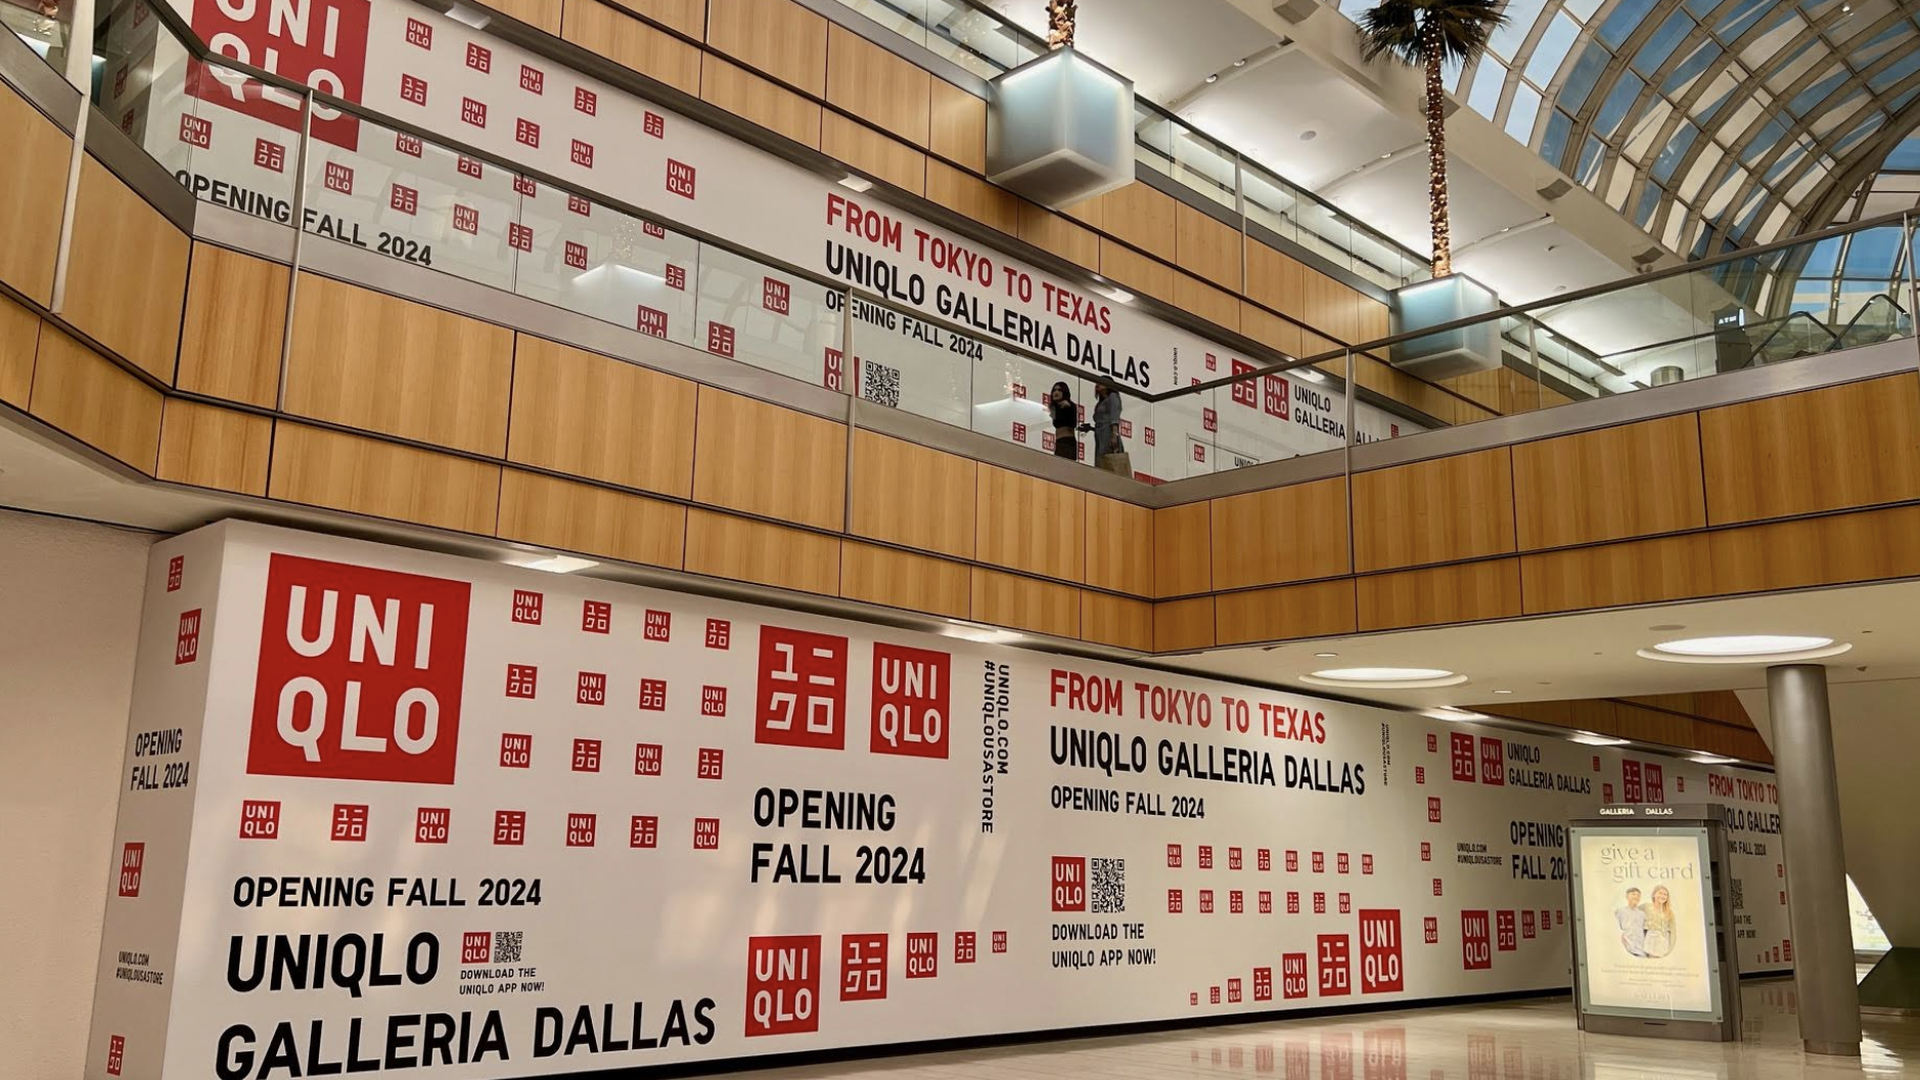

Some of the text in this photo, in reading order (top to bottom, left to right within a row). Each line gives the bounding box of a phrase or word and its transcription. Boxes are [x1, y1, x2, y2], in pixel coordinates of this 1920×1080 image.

[409, 20, 429, 37] UNI
[408, 31, 429, 48] QLO
[522, 67, 540, 84] UNI
[521, 78, 541, 92] QLO
[465, 100, 483, 116] UNI
[464, 110, 484, 125] QLO
[573, 141, 590, 156] UNI
[573, 151, 591, 166] QLO
[328, 164, 350, 181] UNI
[670, 164, 691, 182] UNI
[327, 176, 350, 191] QLO
[668, 177, 692, 197] QLO
[175, 170, 432, 266] OPENING FALL 2024
[456, 206, 475, 221] UNI
[455, 217, 476, 232] QLO
[567, 243, 585, 258] UNI
[566, 253, 586, 268] QLO
[827, 192, 1111, 334] FROM TOKYO TO TEXAS
[766, 281, 785, 298] UNI
[765, 295, 787, 311] QLO
[826, 239, 1150, 388] UNIQLO GALLERIA DALLAS
[903, 317, 943, 348] FALL
[949, 334, 983, 361] 2024
[1266, 378, 1285, 397] UNI
[1267, 395, 1287, 414] QLO
[1294, 384, 1331, 412] UNIQLO
[1295, 407, 1346, 440] GALLERIA
[516, 594, 538, 607] UNI
[515, 607, 539, 621] QLO
[647, 614, 666, 626] UNI
[181, 616, 198, 636] UNI
[287, 585, 434, 669] UNI
[647, 627, 668, 638] QLO
[178, 637, 196, 661] QLO
[581, 676, 601, 688] UNI
[881, 657, 937, 699] UNI
[580, 689, 602, 702] QLO
[704, 690, 722, 702] UNI
[704, 701, 723, 713] QLO
[1051, 669, 1326, 744] FROM TOKYO TO TEXAS
[277, 676, 439, 762] QLO
[880, 703, 941, 747] QLO
[996, 664, 1010, 774] UNIQLO.COM
[135, 728, 183, 757] OPENING
[505, 738, 526, 750] UNI
[982, 660, 995, 833] #UNIQLOUSASTORE
[1483, 743, 1500, 760] UNI
[503, 751, 527, 765] QLO
[639, 747, 658, 759] UNI
[1051, 725, 1365, 795] UNIQLO GALLERIA DALLAS
[1507, 742, 1540, 764] UNIQLO
[638, 760, 659, 773] QLO
[1483, 763, 1502, 780] QLO
[131, 761, 190, 791] FALL 2024
[1509, 768, 1554, 790] GALLERIA
[1557, 774, 1591, 795] DALLAS
[1708, 773, 1733, 798] FROM
[1737, 778, 1764, 803] TOKYO
[1766, 784, 1778, 804] TO
[754, 787, 896, 831] OPENING
[1051, 785, 1205, 819] OPENING FALL 2024
[246, 805, 274, 819] UNI
[421, 812, 444, 825] UNI
[244, 821, 275, 836] QLO
[570, 816, 590, 828] UNI
[695, 823, 714, 834] UNI
[418, 825, 445, 839] QLO
[570, 831, 592, 844] QLO
[1510, 821, 1563, 848] OPENING
[695, 835, 715, 848] QLO
[124, 849, 141, 868] UNI
[1601, 843, 1655, 865] give a
[751, 843, 925, 884] FALL 2024
[1056, 863, 1080, 882] UNI
[1512, 855, 1546, 880] FALL
[1613, 861, 1694, 883] gift card
[121, 872, 139, 893] QLO
[233, 875, 541, 907] OPENING FALL 2024
[1056, 886, 1082, 908] QLO
[1052, 923, 1144, 940] DOWNLOAD THE
[1364, 920, 1394, 947] UNI
[1464, 918, 1485, 937] UNI
[465, 936, 486, 946] UNI
[910, 938, 932, 954] UNI
[463, 948, 488, 960] QLO
[1052, 948, 1156, 970] UNIQLO APP NOW!
[1466, 942, 1488, 965] QLO
[226, 931, 440, 998] UNIQLO
[460, 967, 536, 980] DOWNLOAD THE
[756, 948, 808, 981] UNI
[909, 957, 934, 975] QLO
[1285, 959, 1303, 974] UNI
[1365, 954, 1399, 987] QLO
[459, 981, 545, 996] UNIQLO APP NOW!
[1286, 977, 1305, 996] QLO
[754, 988, 812, 1028] QLO
[215, 998, 716, 1080] GALLERIA DALLAS
